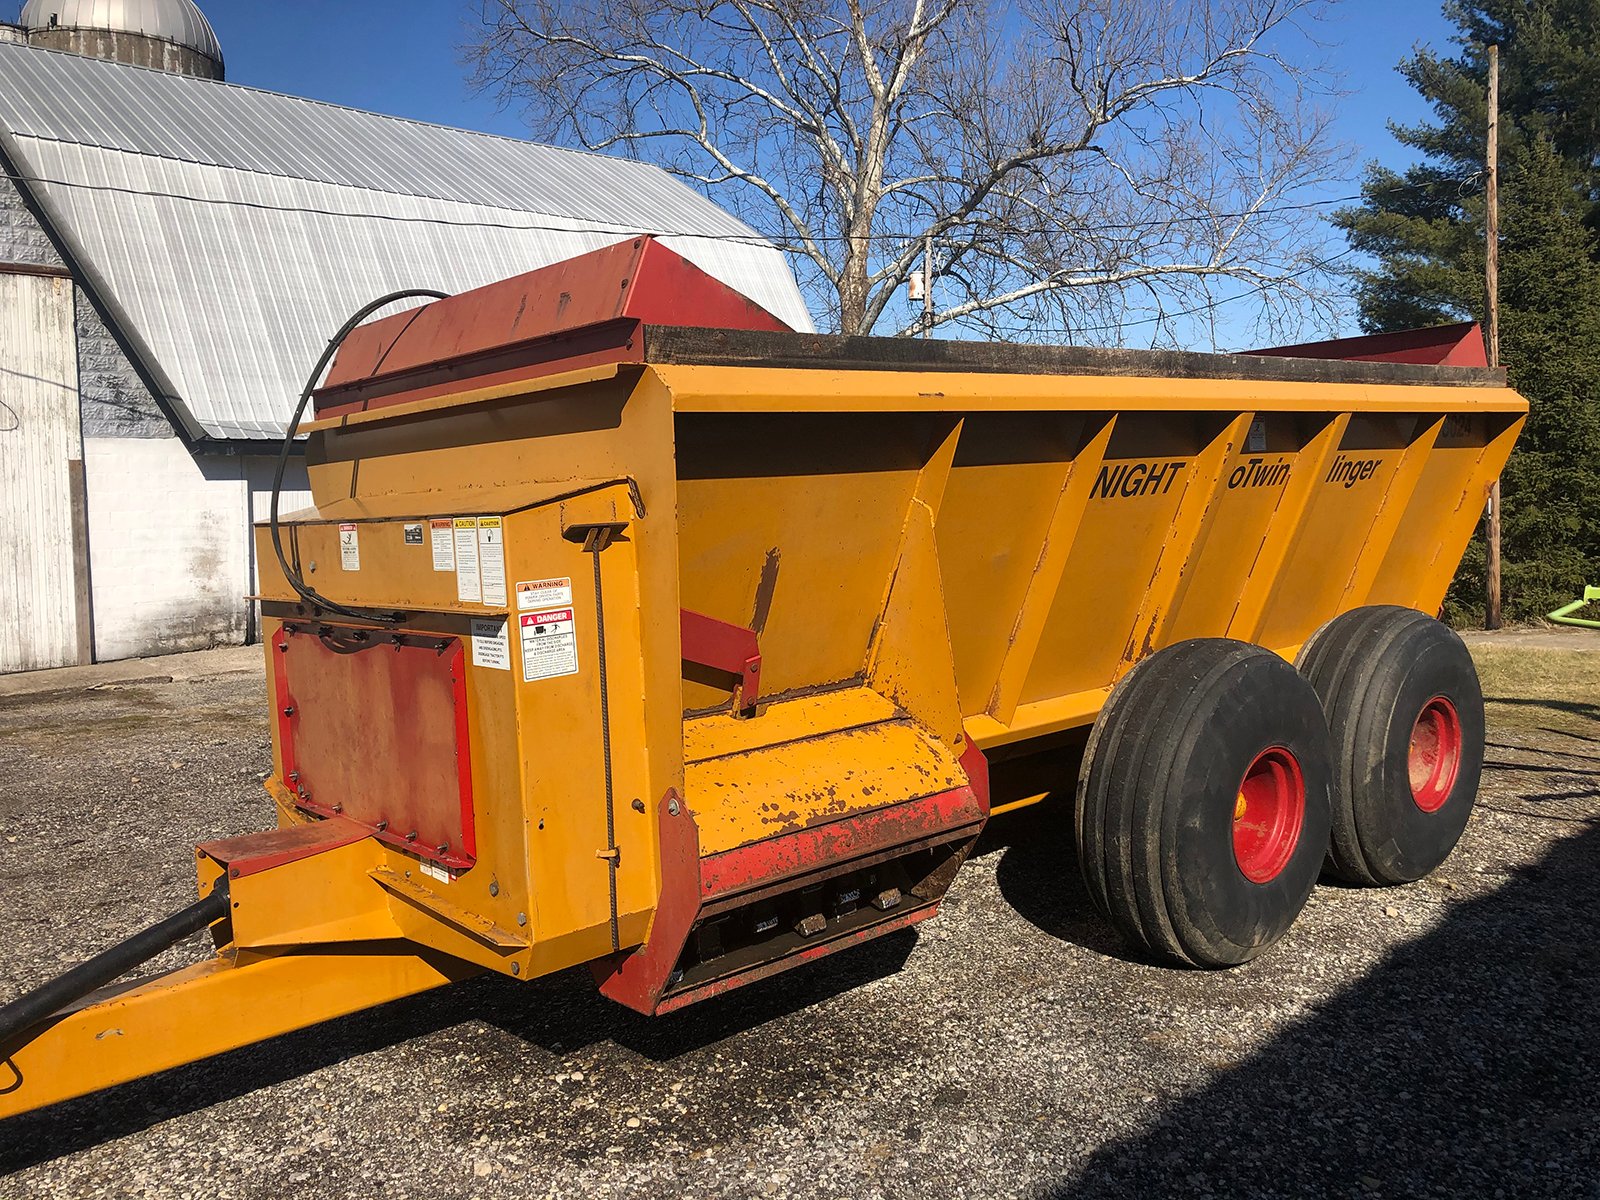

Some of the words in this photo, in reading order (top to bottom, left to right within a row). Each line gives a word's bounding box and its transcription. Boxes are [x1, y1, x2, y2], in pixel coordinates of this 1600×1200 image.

[1088, 462, 1187, 499] NIGHT
[1227, 457, 1291, 489] oTwin
[1325, 455, 1383, 488] linger
[532, 580, 564, 589] WARNING
[536, 612, 567, 623] DANGER
